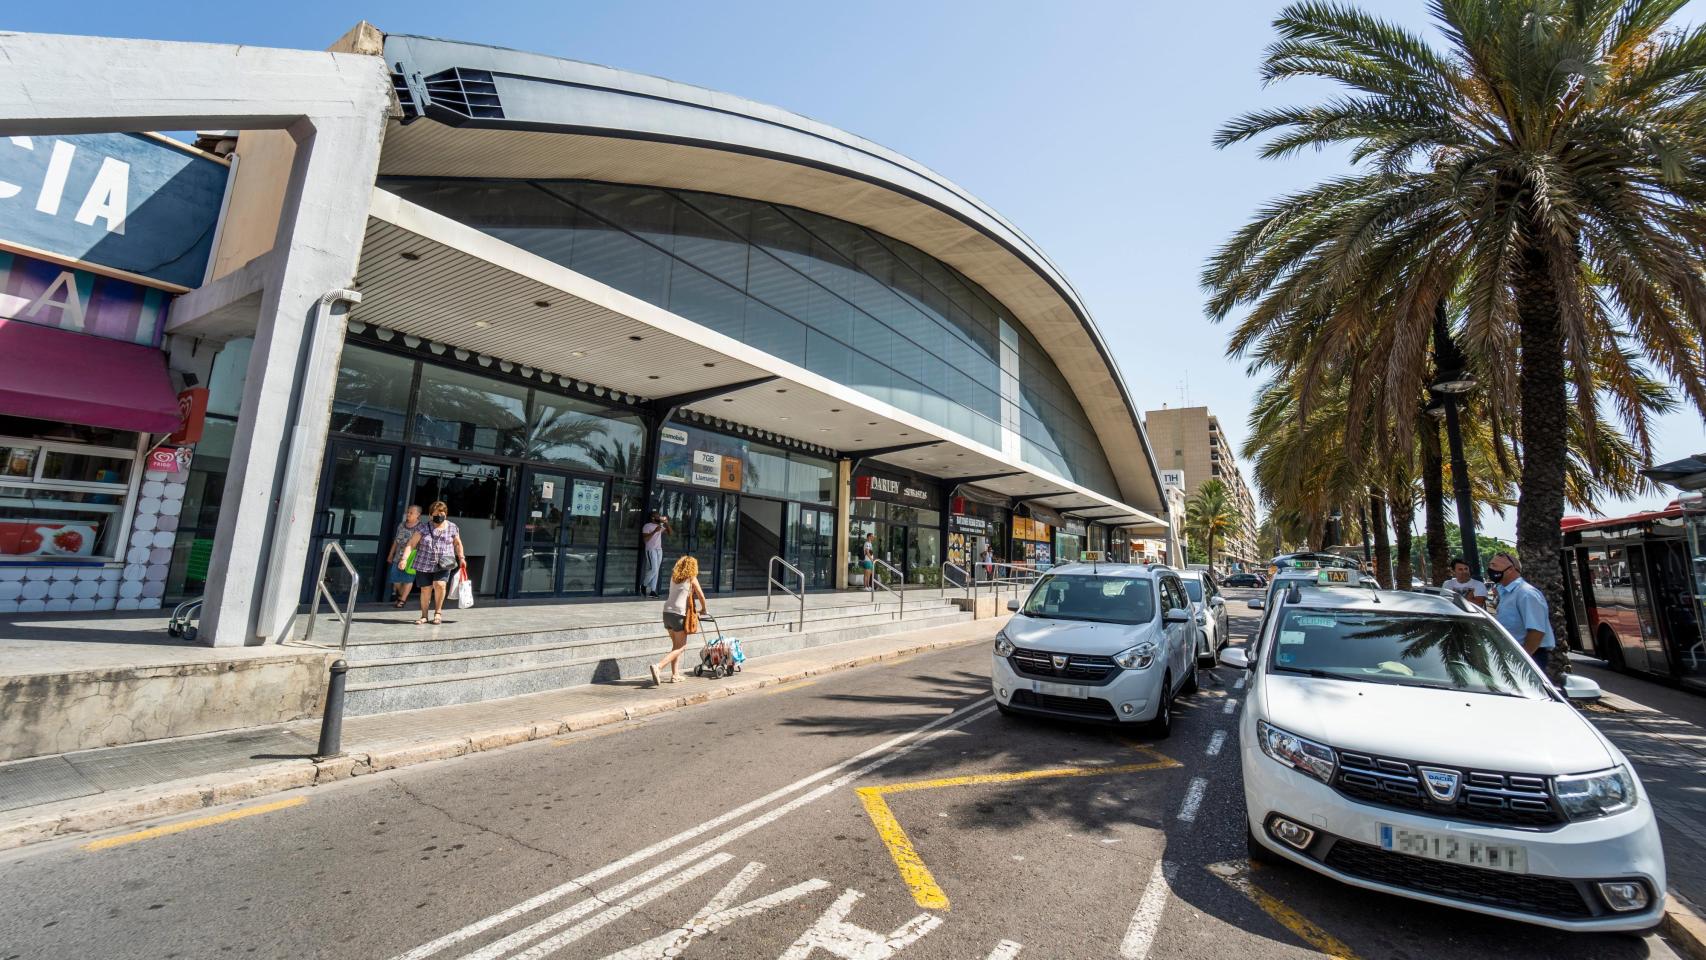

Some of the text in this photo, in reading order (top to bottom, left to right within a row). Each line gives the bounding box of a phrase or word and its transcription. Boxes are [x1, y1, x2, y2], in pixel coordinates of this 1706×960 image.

[702, 453, 715, 463] 7GB
[1328, 571, 1348, 582] TAXI
[1428, 774, 1453, 784] DACIA
